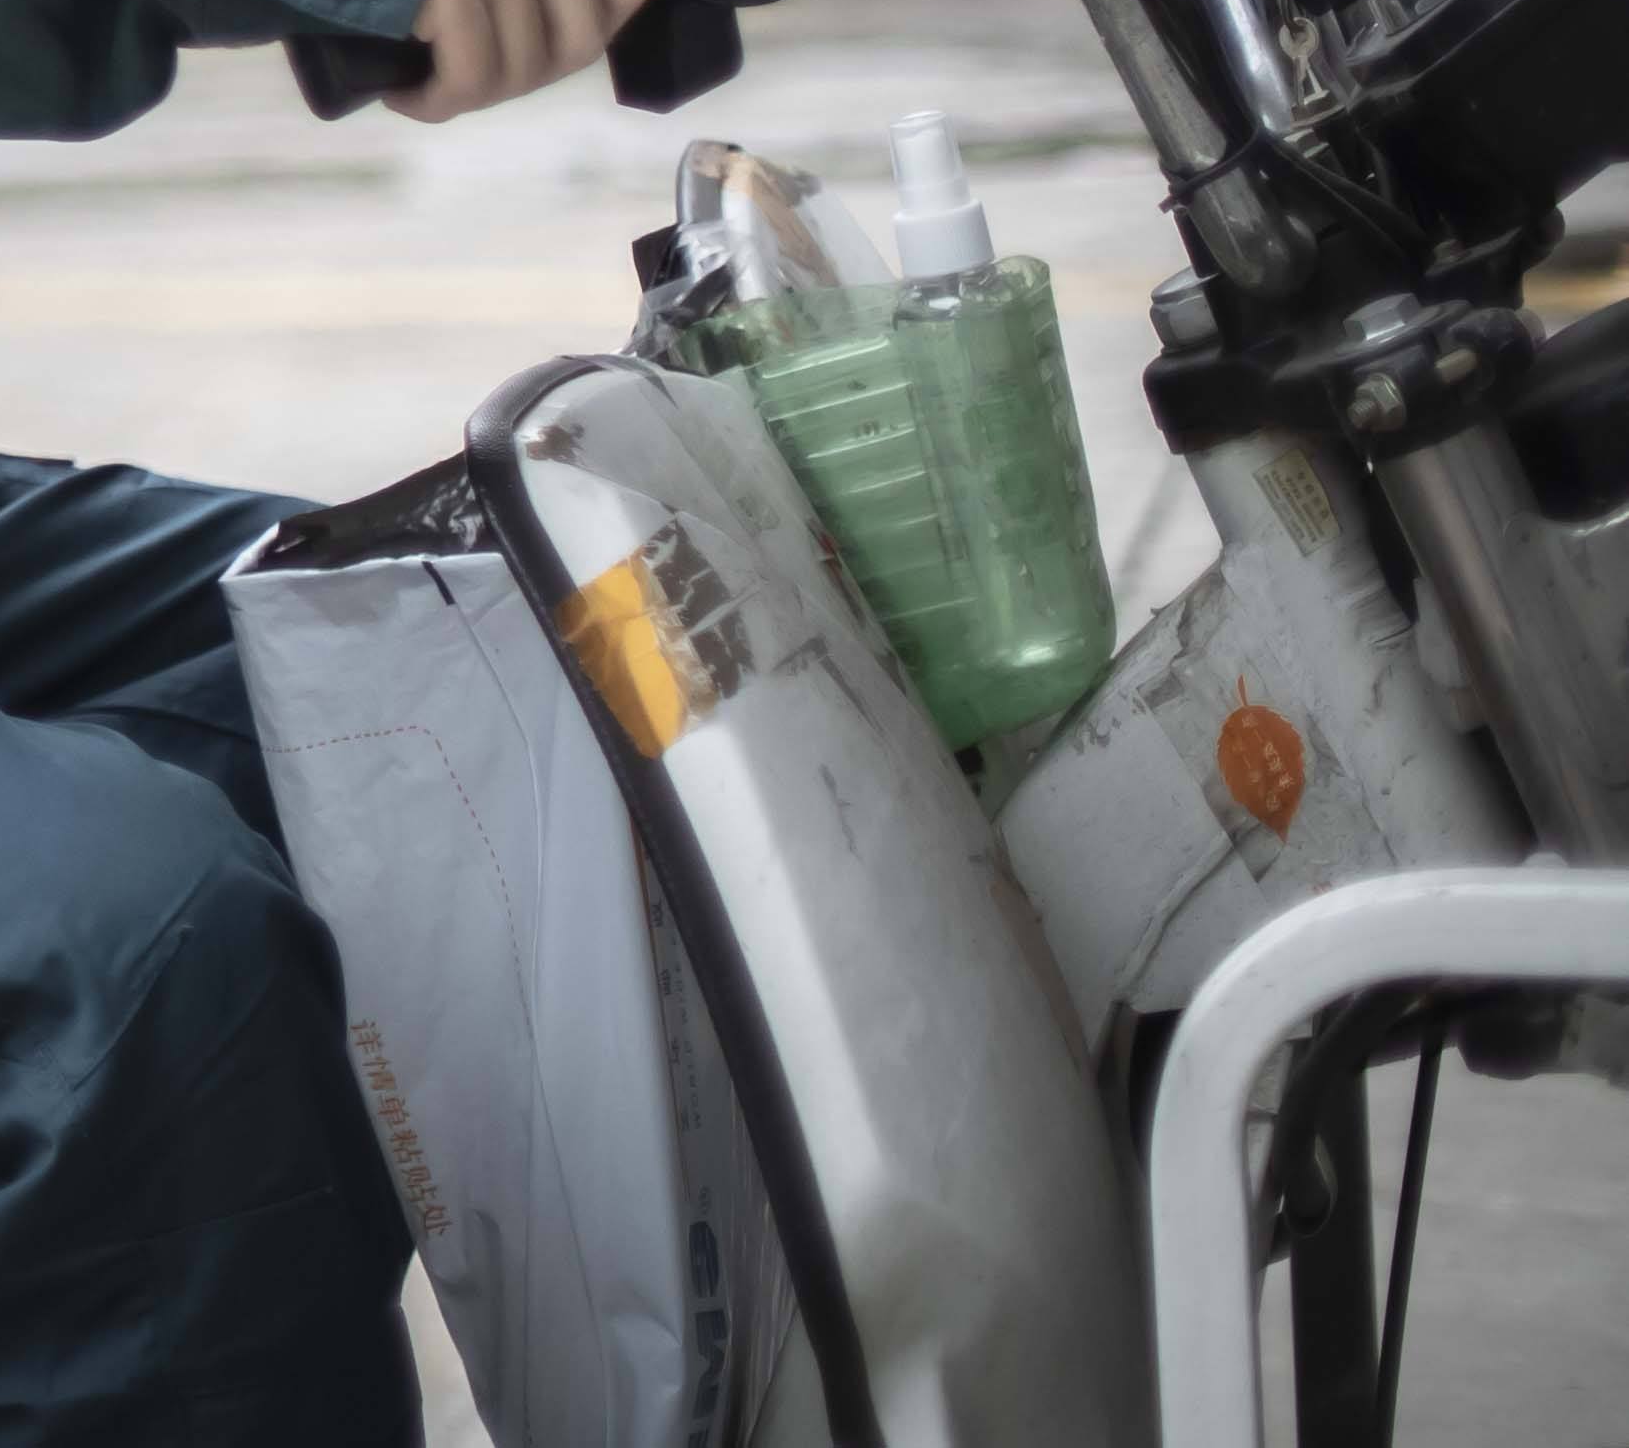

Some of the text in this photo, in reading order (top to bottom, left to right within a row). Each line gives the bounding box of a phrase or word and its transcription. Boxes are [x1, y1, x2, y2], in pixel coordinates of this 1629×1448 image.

[350, 1018, 454, 1237] 详情单粘贴处
